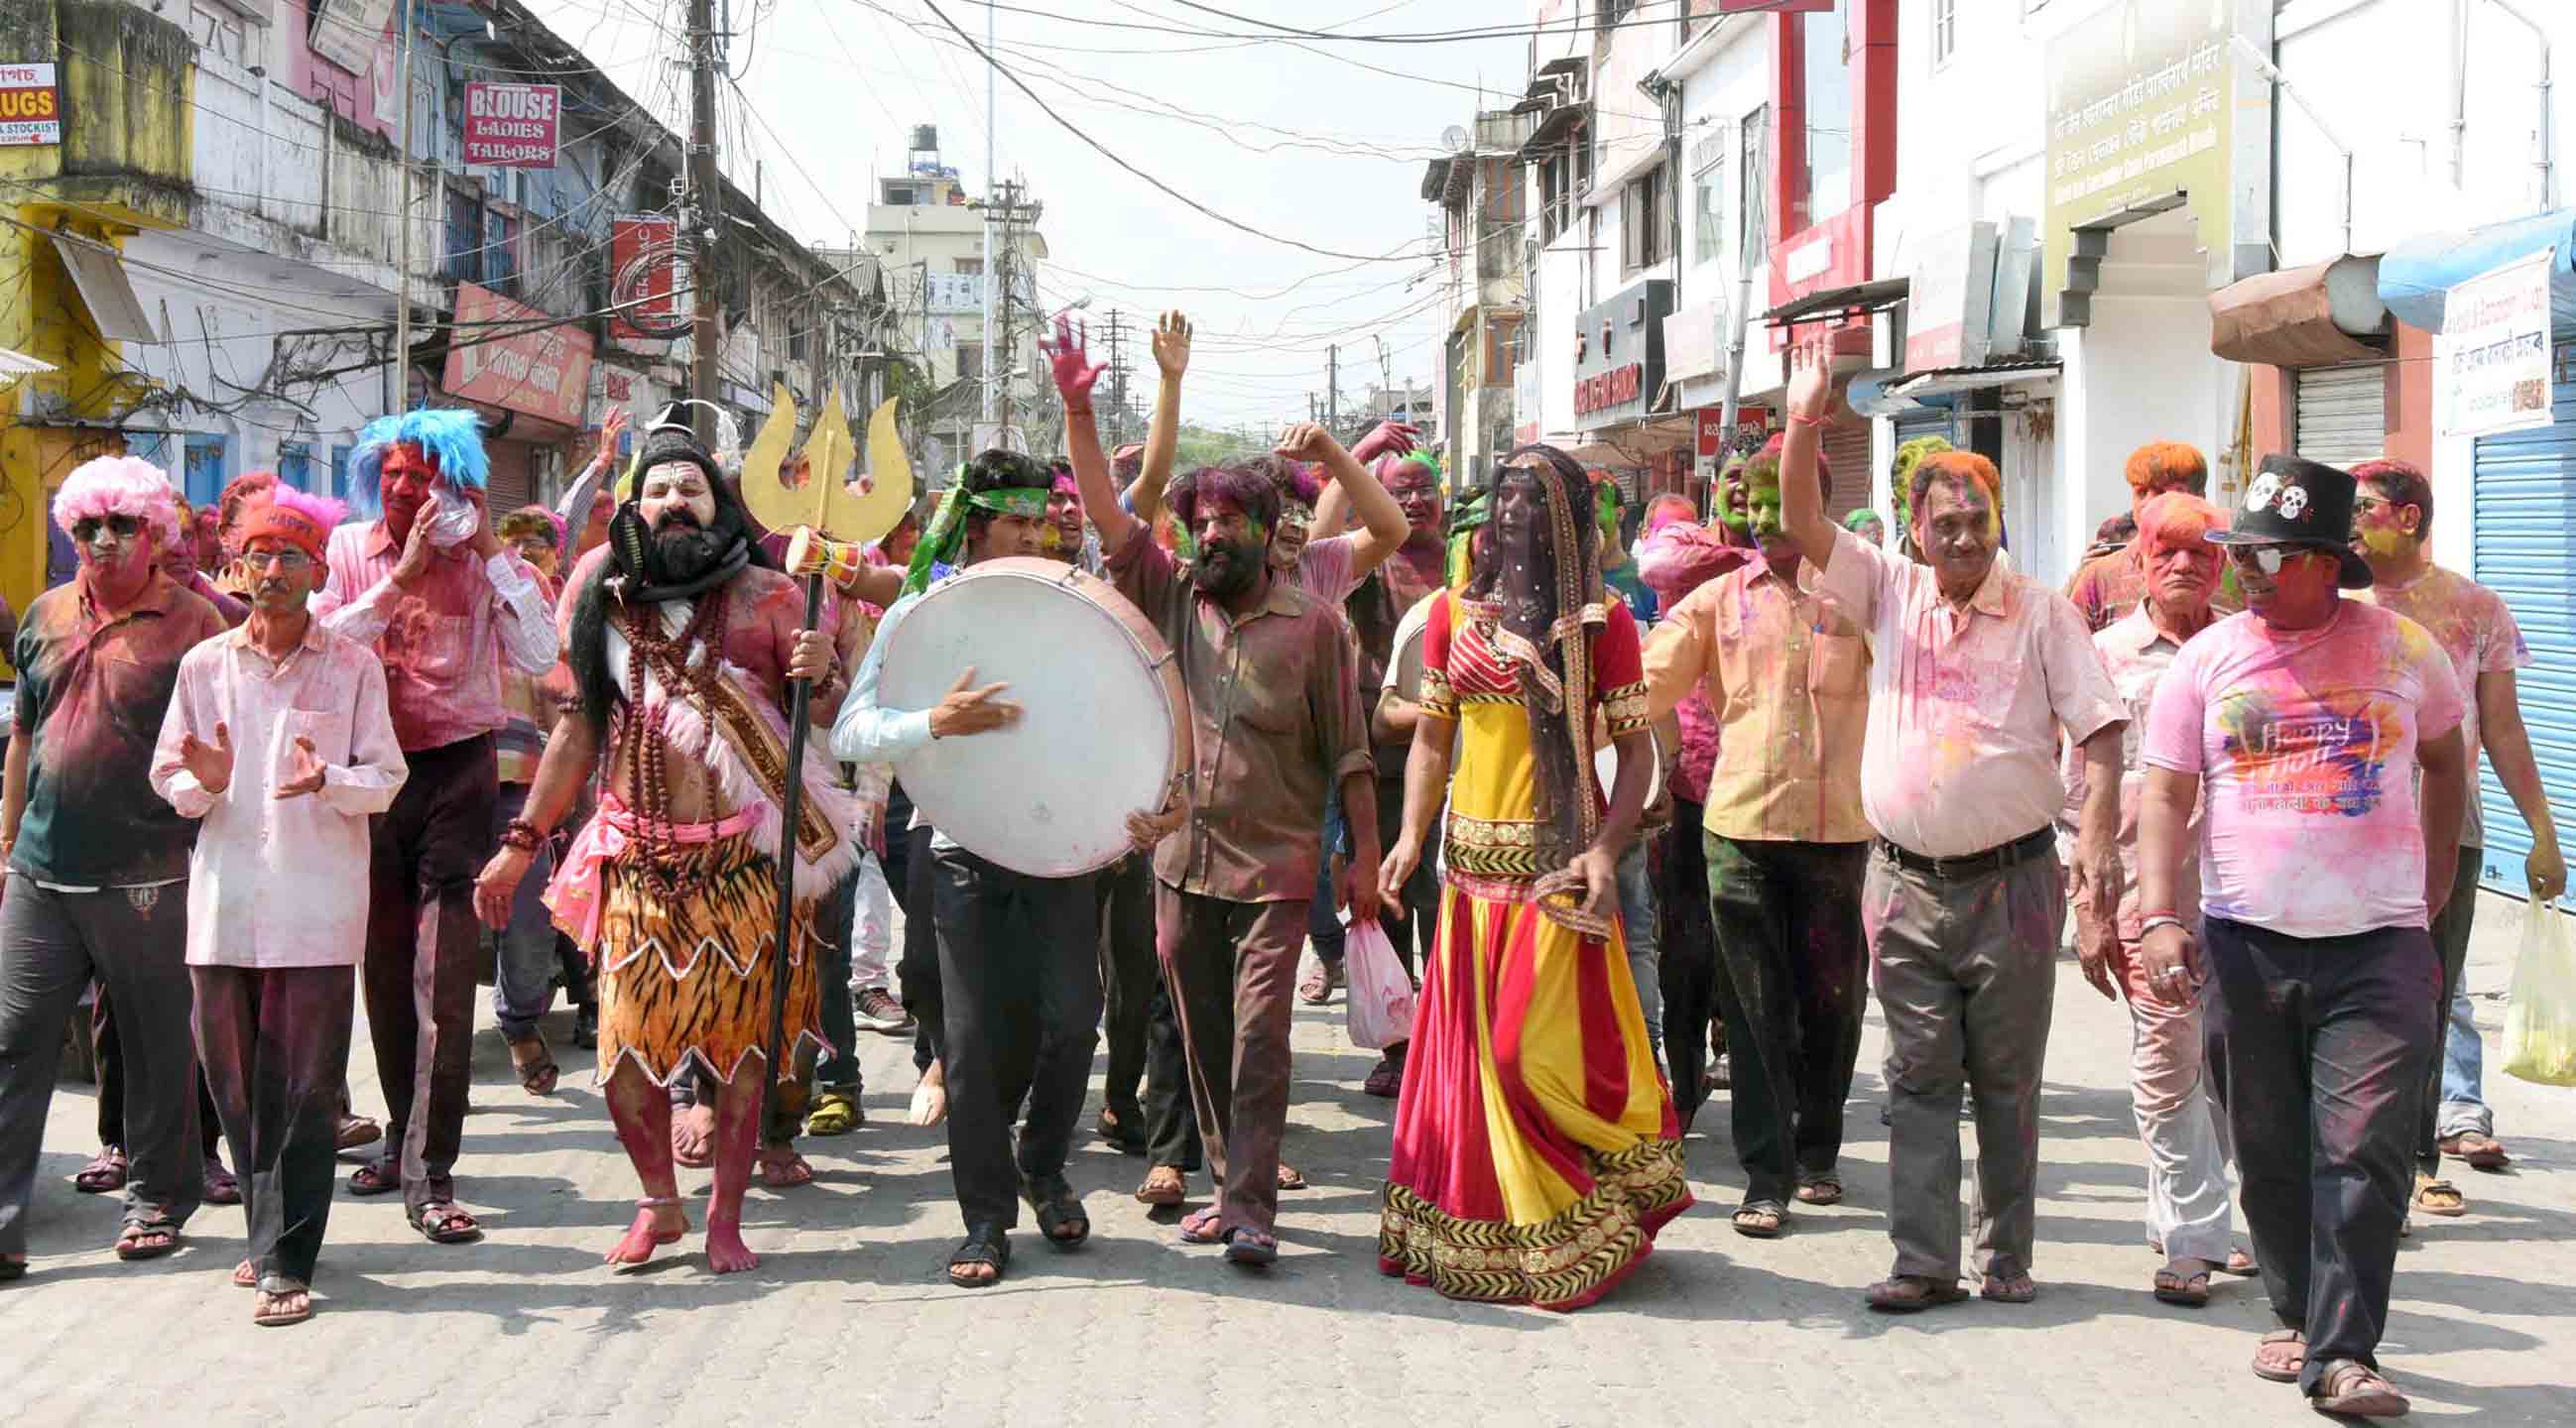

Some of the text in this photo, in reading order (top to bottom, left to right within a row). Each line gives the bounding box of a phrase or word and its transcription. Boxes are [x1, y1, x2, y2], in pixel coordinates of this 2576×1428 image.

[0, 91, 53, 116] UGS
[471, 89, 553, 120] BLOUSE
[8, 123, 57, 133] STOCKIST
[476, 120, 545, 138] LADIES
[468, 143, 550, 160] TAILORS
[2262, 717, 2350, 754] Happy
